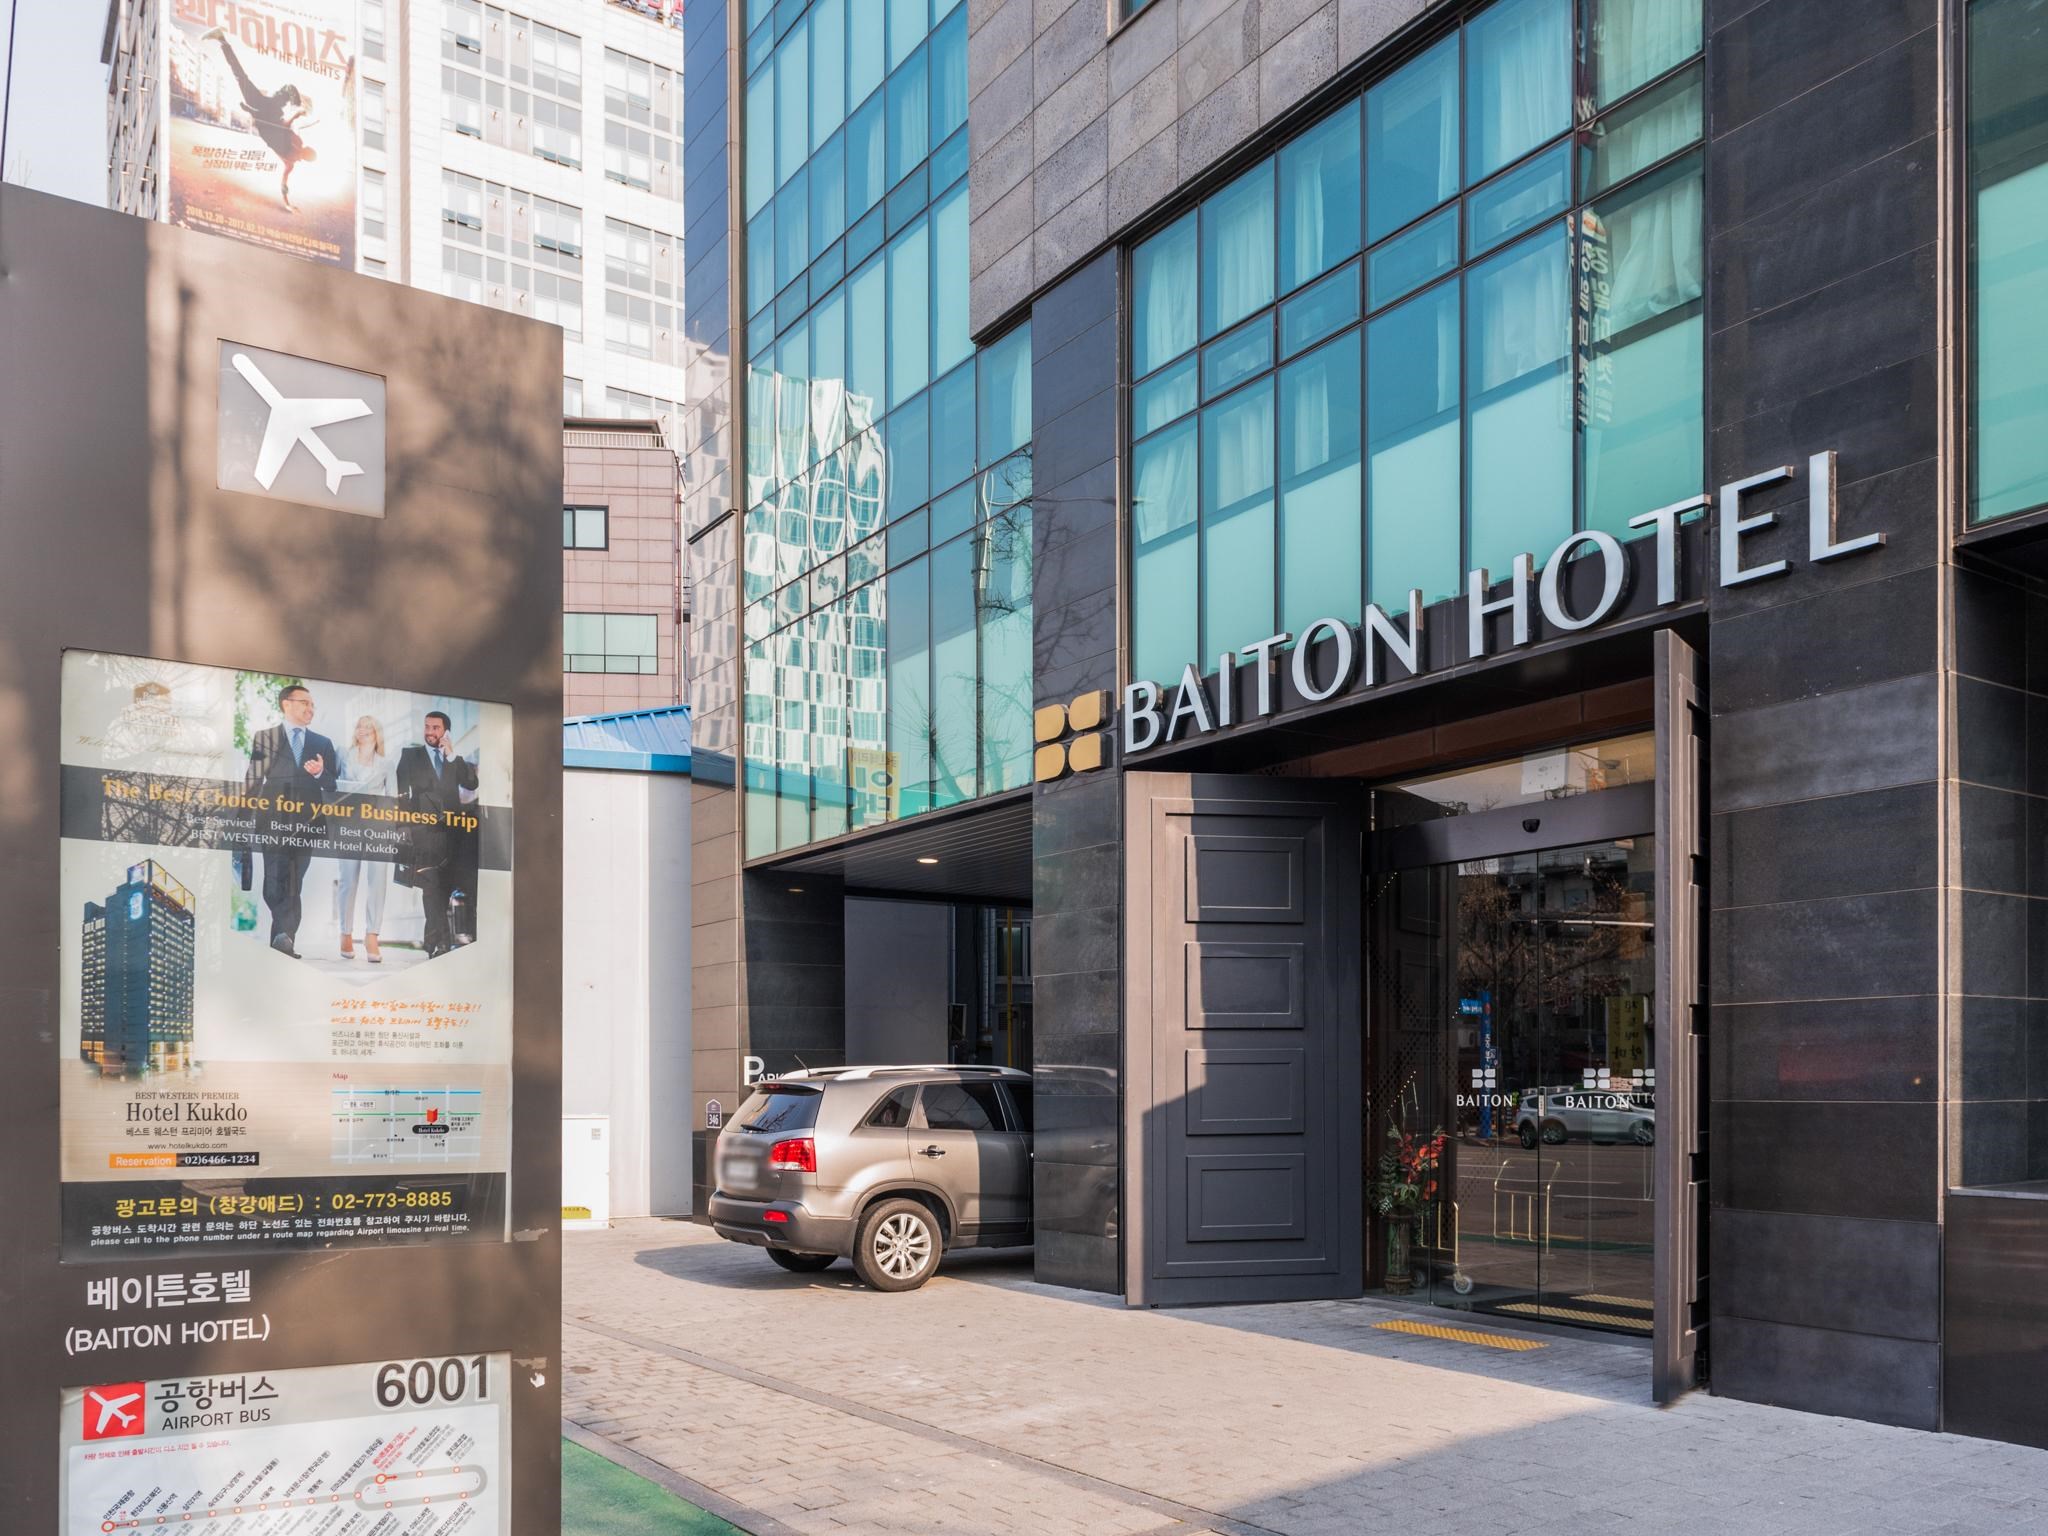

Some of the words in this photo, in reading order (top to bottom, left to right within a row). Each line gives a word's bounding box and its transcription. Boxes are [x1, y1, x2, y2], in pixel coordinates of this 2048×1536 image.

[257, 43, 269, 56] IN
[273, 48, 292, 65] THE
[295, 55, 342, 81] HEIGHTS
[1125, 589, 1425, 754] BAITON
[1468, 450, 1886, 657] HOTEL
[102, 777, 140, 799] The
[149, 784, 193, 804] Best
[199, 789, 269, 810] Choice
[276, 794, 304, 813] for
[311, 801, 354, 820] your
[361, 803, 438, 826] Business
[443, 811, 478, 833] Trip
[185, 814, 210, 825] Best
[213, 816, 256, 829] Service!
[271, 821, 292, 832] Best
[296, 824, 326, 835] Price!
[340, 827, 361, 838] Best
[364, 829, 406, 846] Quality!
[191, 830, 218, 841] BEST
[223, 831, 279, 845] WESTERN
[282, 837, 329, 849] PREMIER
[334, 840, 362, 852] Hotel
[365, 843, 398, 855] Kukdo
[332, 1073, 348, 1081] Map
[135, 1092, 157, 1100] BEST
[159, 1092, 199, 1100] WESTERN
[201, 1092, 240, 1100] PREMIER
[1456, 1094, 1514, 1107] BAITON
[1565, 1095, 1630, 1109] BAITON
[126, 1102, 180, 1122] Hotel
[186, 1102, 248, 1122] Kukdo
[708, 1113, 719, 1126] 346
[126, 1127, 151, 1137] 베스트
[153, 1127, 178, 1137] 웨스턴
[181, 1127, 213, 1137] 프리미어
[215, 1126, 247, 1136] 호텔국도
[147, 1142, 228, 1150] www.hotelkukdo.com
[116, 1156, 172, 1167] Reservation
[184, 1154, 256, 1165] 02)6466-1234
[115, 1197, 198, 1218] 광고문의
[209, 1194, 304, 1216] (창강애드)
[332, 1191, 452, 1210] 02-773-8885
[91, 1224, 132, 1236] 공항버스
[137, 1223, 176, 1234] 도착시간
[181, 1222, 201, 1232] 관련
[206, 1221, 235, 1232] 문의는
[239, 1220, 257, 1230] 하단
[262, 1219, 290, 1229] 노선도
[294, 1218, 313, 1228] 있는
[317, 1216, 361, 1227] 전화번호를
[366, 1215, 401, 1226] 참고하여
[404, 1214, 430, 1224] 주시기
[434, 1213, 470, 1223] 바랍니다.
[91, 1237, 120, 1247] please
[124, 1236, 140, 1245] call
[144, 1236, 153, 1244] to
[156, 1235, 170, 1244] the
[173, 1235, 200, 1244] phone
[203, 1233, 233, 1242] number
[237, 1232, 261, 1240] under
[273, 1231, 293, 1239] route
[297, 1231, 313, 1239] map
[316, 1229, 354, 1238] regarding
[357, 1227, 384, 1236] Airport
[387, 1226, 421, 1234] limousine
[452, 1224, 470, 1232] time.
[87, 1269, 251, 1311] 베이튼호텔
[65, 1323, 171, 1356] (BAITON
[181, 1314, 270, 1344] HOTEL)
[376, 1355, 488, 1407] 6001
[154, 1375, 278, 1413] 공항버스
[162, 1411, 233, 1431] AIRPORT
[240, 1408, 271, 1423] BUS
[102, 1488, 136, 1520] 인천국제공항
[130, 1486, 163, 1518] 한강대교북단
[156, 1492, 178, 1515] 신용산역
